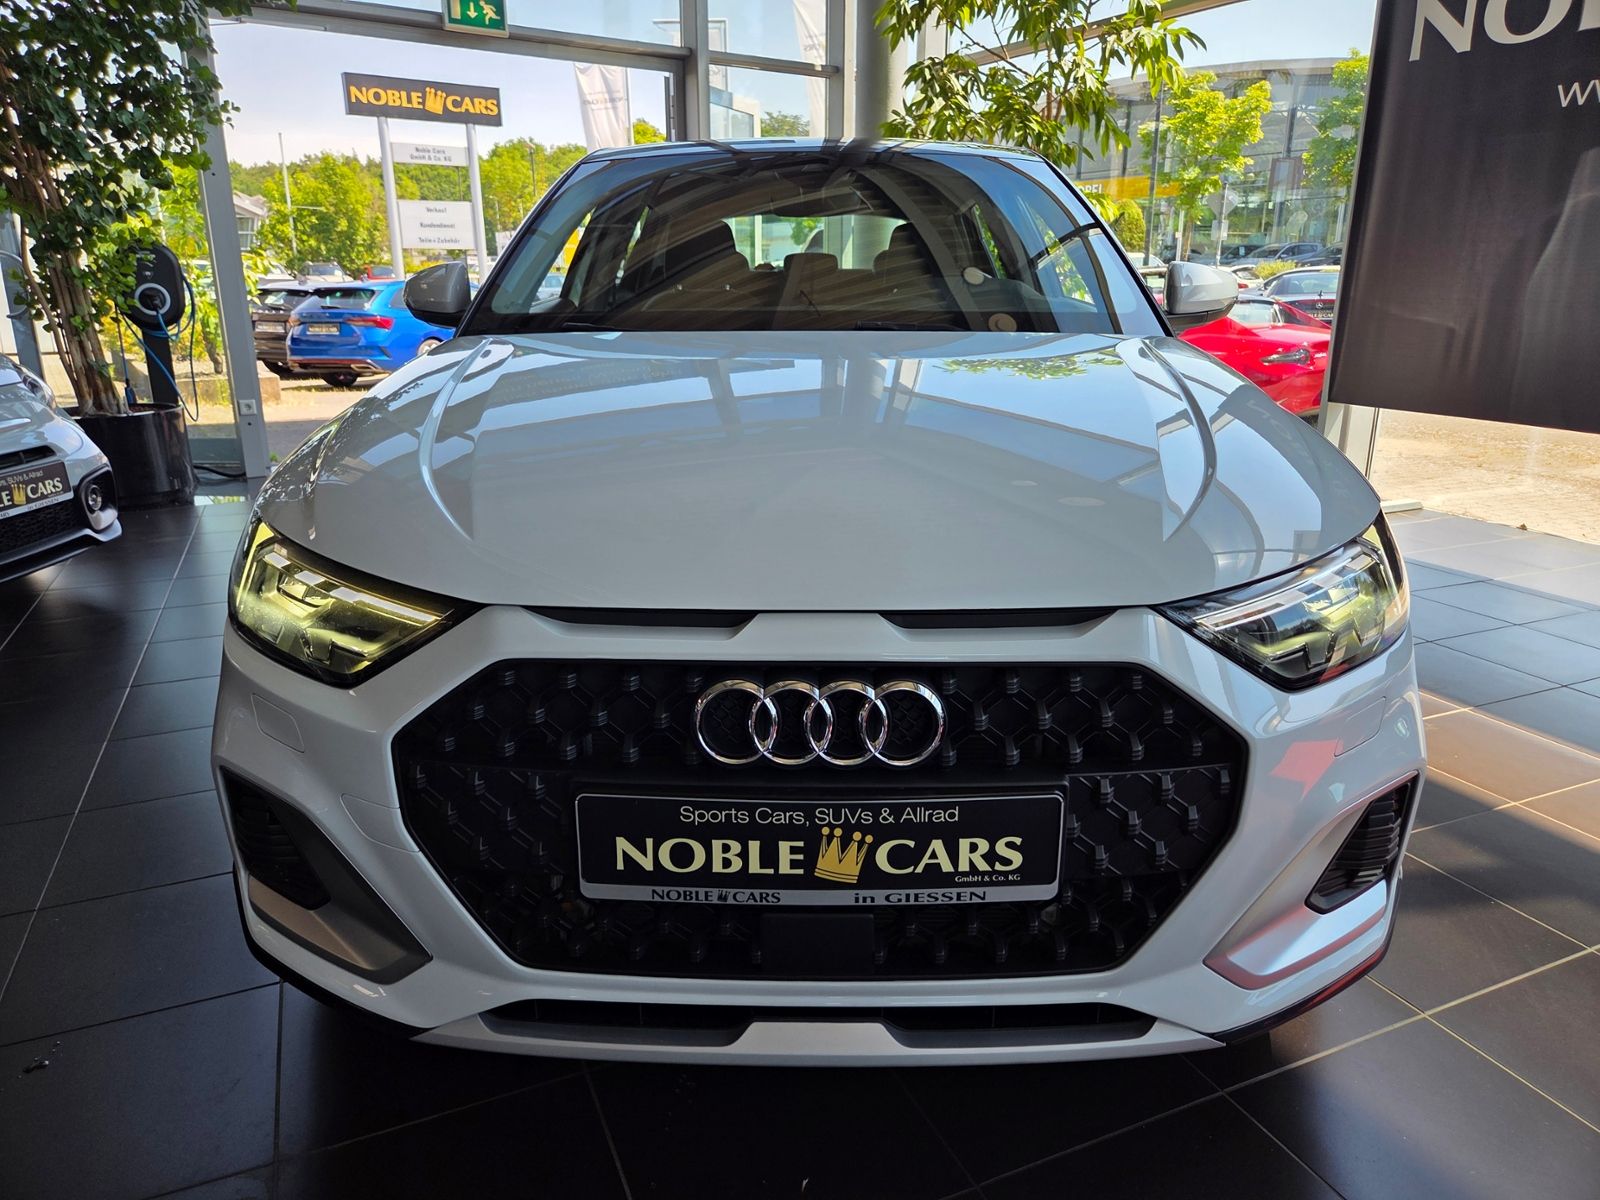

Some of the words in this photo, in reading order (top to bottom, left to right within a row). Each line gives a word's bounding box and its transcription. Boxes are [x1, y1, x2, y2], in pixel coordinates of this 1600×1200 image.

[1408, 0, 1600, 62] NO
[349, 85, 423, 109] NOBLE
[446, 95, 499, 116] CARS
[415, 146, 431, 154] Noble
[432, 147, 446, 155] Cars
[26, 477, 63, 499] CARS
[680, 805, 749, 826] Sports
[755, 807, 809, 827] Cars,
[815, 808, 873, 825] SUVs
[879, 807, 896, 824] &
[900, 806, 959, 823] Allrad
[615, 836, 805, 875] NOBLE
[875, 836, 1023, 875] CARS
[954, 874, 982, 883] GmbH
[983, 875, 991, 883] &
[993, 874, 1006, 882] Co.
[1008, 873, 1021, 881] KG
[651, 888, 713, 902] NOBLE
[732, 890, 781, 904] CARS
[854, 892, 876, 904] in
[884, 891, 986, 903] GIESSEN
